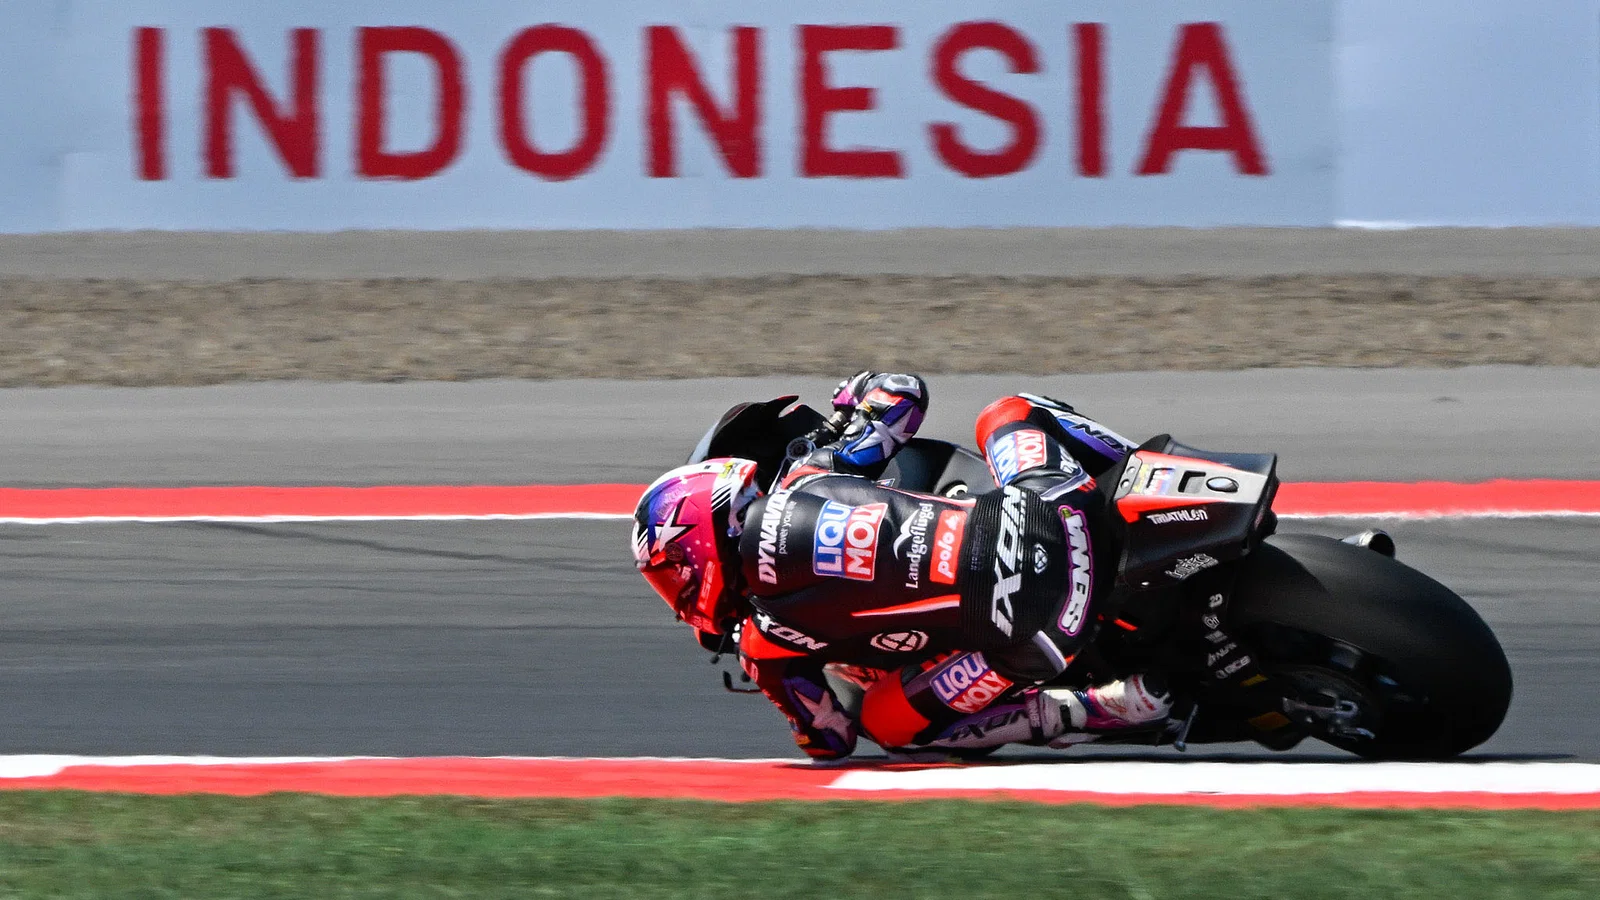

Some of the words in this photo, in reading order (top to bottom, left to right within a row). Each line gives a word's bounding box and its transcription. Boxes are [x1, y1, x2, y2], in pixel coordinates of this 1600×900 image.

[131, 22, 1271, 182] INDONESIA
[845, 506, 881, 575] MOLY
[906, 502, 934, 589] Landgeflügel
[937, 531, 957, 579] polo
[992, 485, 1022, 638] IXON
[1060, 512, 1092, 634] SENNA
[757, 612, 829, 650] XON
[953, 671, 1010, 711] MOLY
